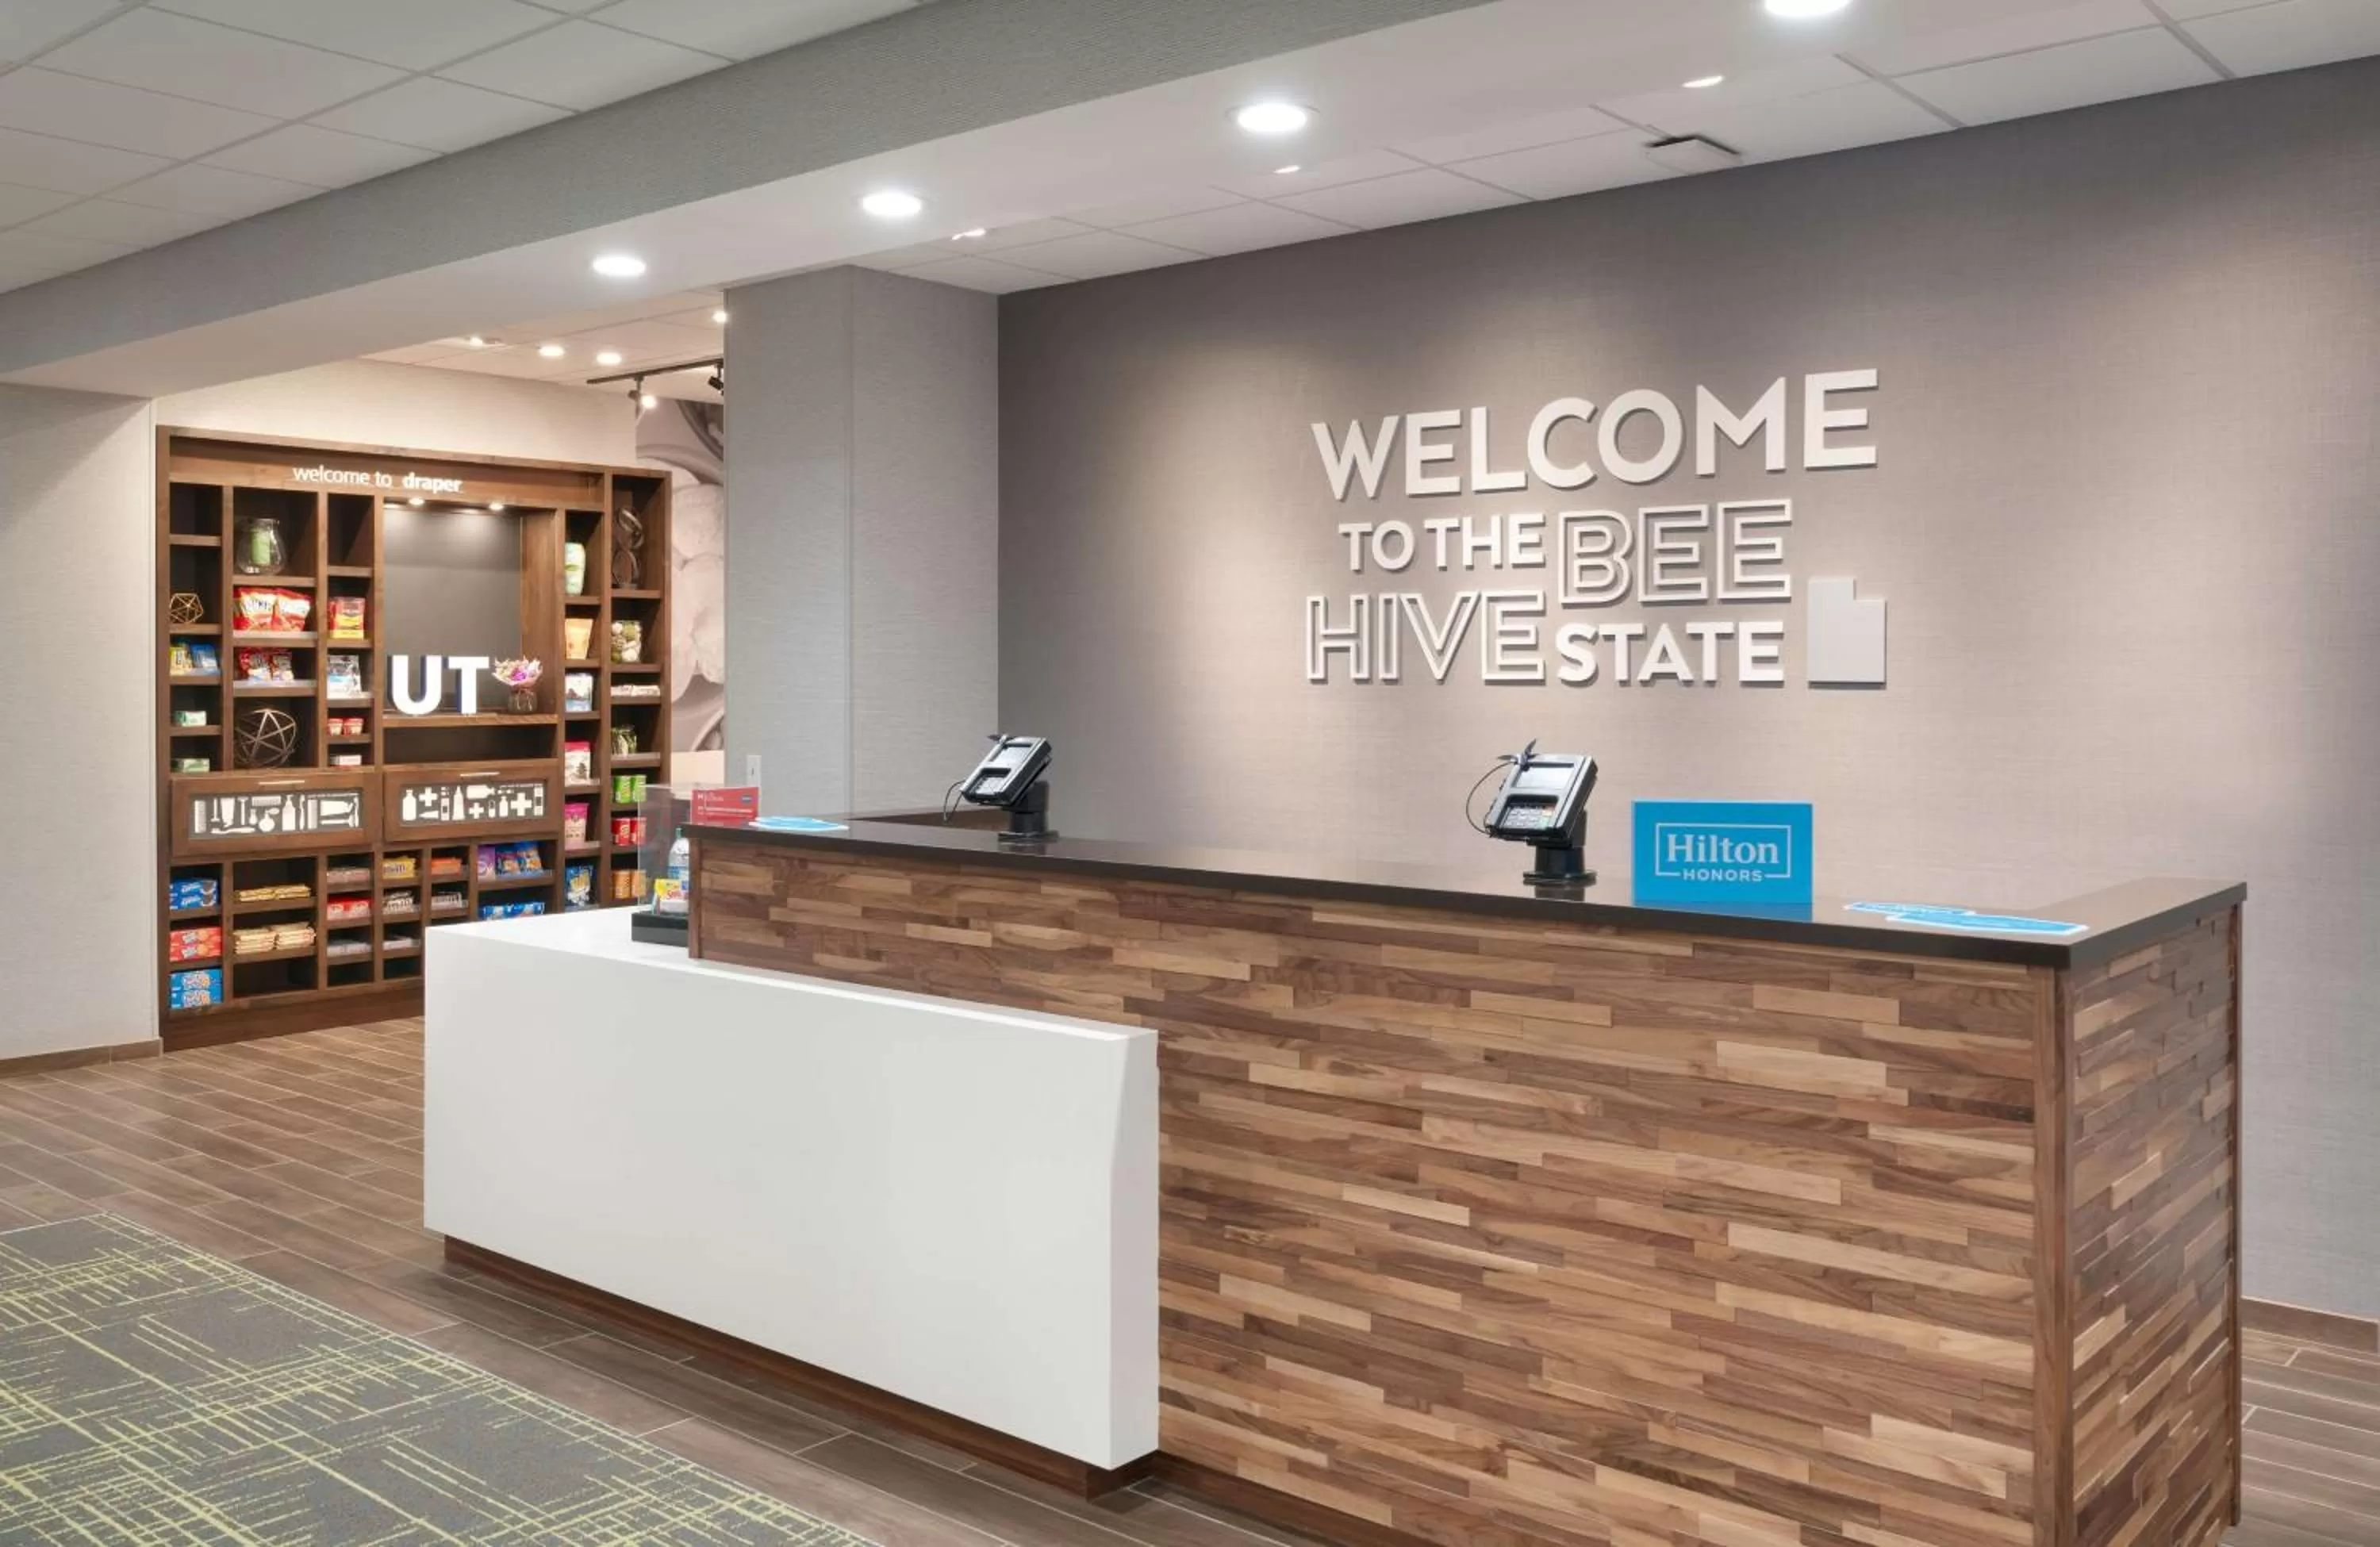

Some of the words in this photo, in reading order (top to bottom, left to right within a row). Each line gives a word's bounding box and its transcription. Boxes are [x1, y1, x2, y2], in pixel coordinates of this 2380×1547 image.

[1311, 368, 1878, 501] WELCOME
[293, 465, 370, 486] welcome
[375, 471, 392, 488] to
[402, 472, 463, 493] draper
[1338, 520, 1415, 571] TO
[1424, 513, 1546, 570] THE
[1558, 499, 1792, 605] BEE
[1307, 590, 1546, 681] HIVE
[1557, 621, 1784, 683] STATE
[390, 654, 489, 714] UT
[1667, 834, 1779, 864] Hilton
[1683, 869, 1764, 882] HONORS
